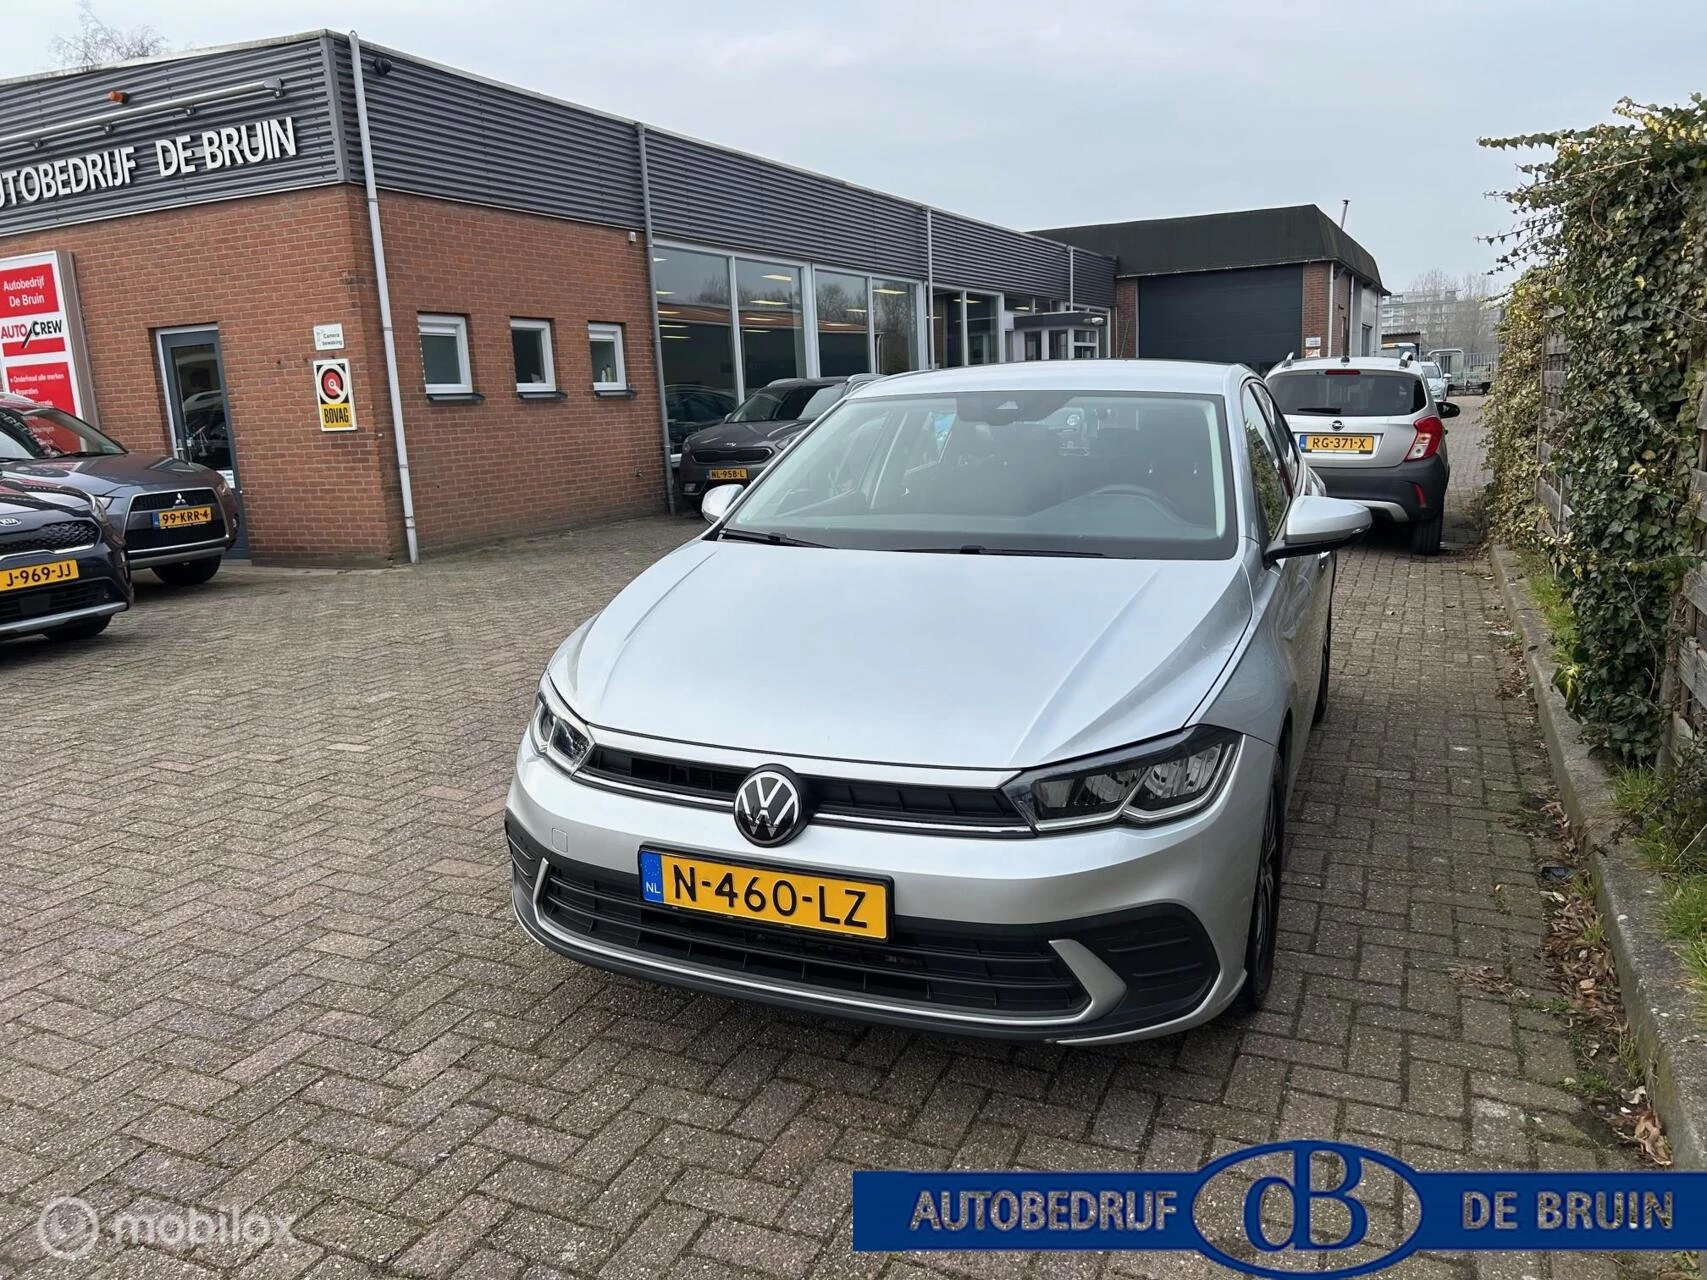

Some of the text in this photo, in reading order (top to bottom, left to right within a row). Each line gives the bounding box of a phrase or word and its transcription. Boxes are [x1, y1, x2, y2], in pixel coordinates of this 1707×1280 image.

[155, 135, 196, 177] DE
[202, 116, 297, 170] BRUIN
[3, 275, 45, 292] Autobedrijf
[9, 293, 45, 308] De Bruin
[323, 407, 349, 424] BOVAG
[1312, 437, 1366, 449] RG-371-X
[711, 470, 745, 479] NL-958-L
[162, 509, 209, 525] 99-KRR-4
[645, 864, 868, 929] NL N-460-LZ
